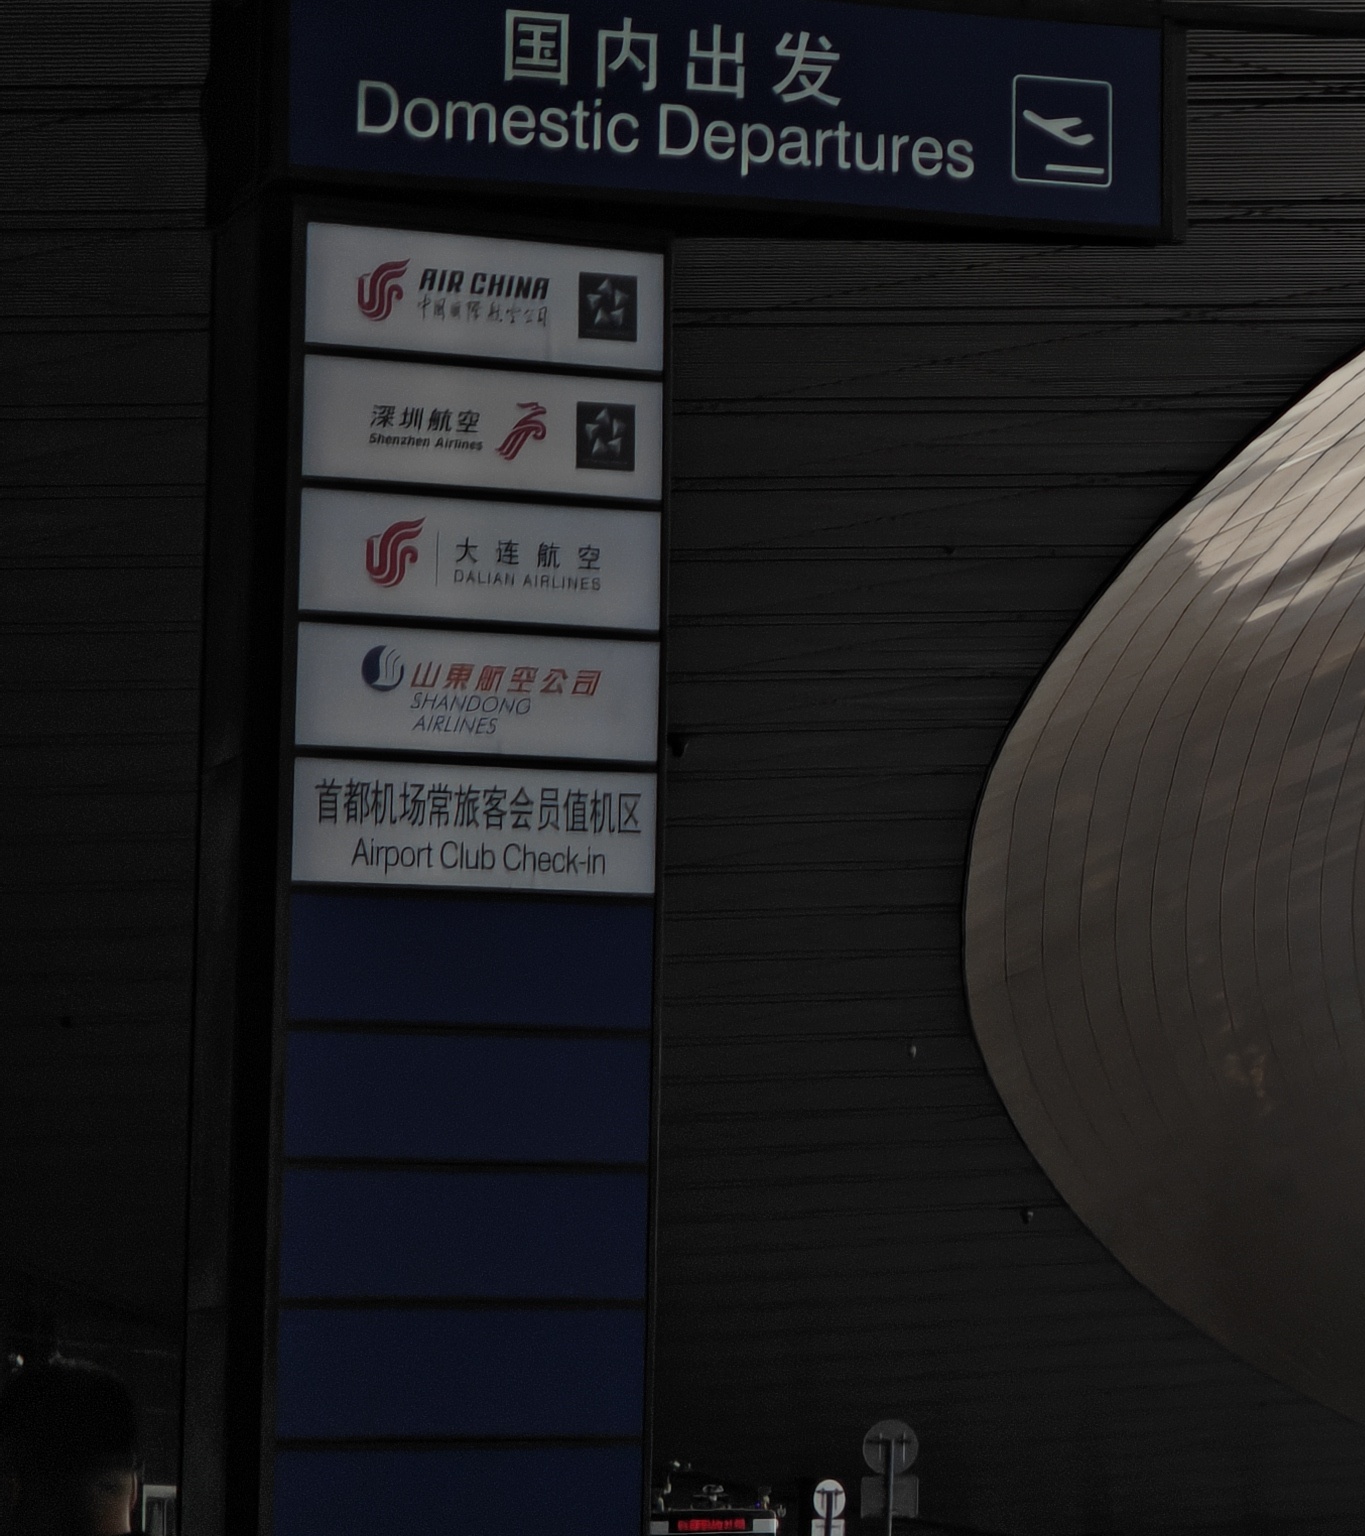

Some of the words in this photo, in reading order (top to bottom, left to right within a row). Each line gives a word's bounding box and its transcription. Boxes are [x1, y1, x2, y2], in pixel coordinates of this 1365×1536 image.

[503, 8, 842, 107] 国内出发
[356, 78, 640, 154] Domestic
[657, 103, 976, 179] Departures
[419, 268, 464, 293] AIR
[470, 272, 550, 300] CHINA
[370, 404, 480, 433] 深圳航空
[369, 432, 430, 447] Shenzhen
[435, 436, 483, 451] Airlines
[455, 536, 601, 570] 大连航空
[454, 569, 515, 586] DALIAN
[523, 574, 602, 592] AIRLINES
[410, 661, 604, 697] 山東航空公司
[410, 692, 532, 716] SHANDONG
[412, 714, 499, 735] AIRLINES
[315, 777, 642, 834] 首都机场常旅客会员值机区
[351, 837, 434, 875] Airport
[440, 840, 495, 872] Club
[503, 843, 607, 875] Check-in
